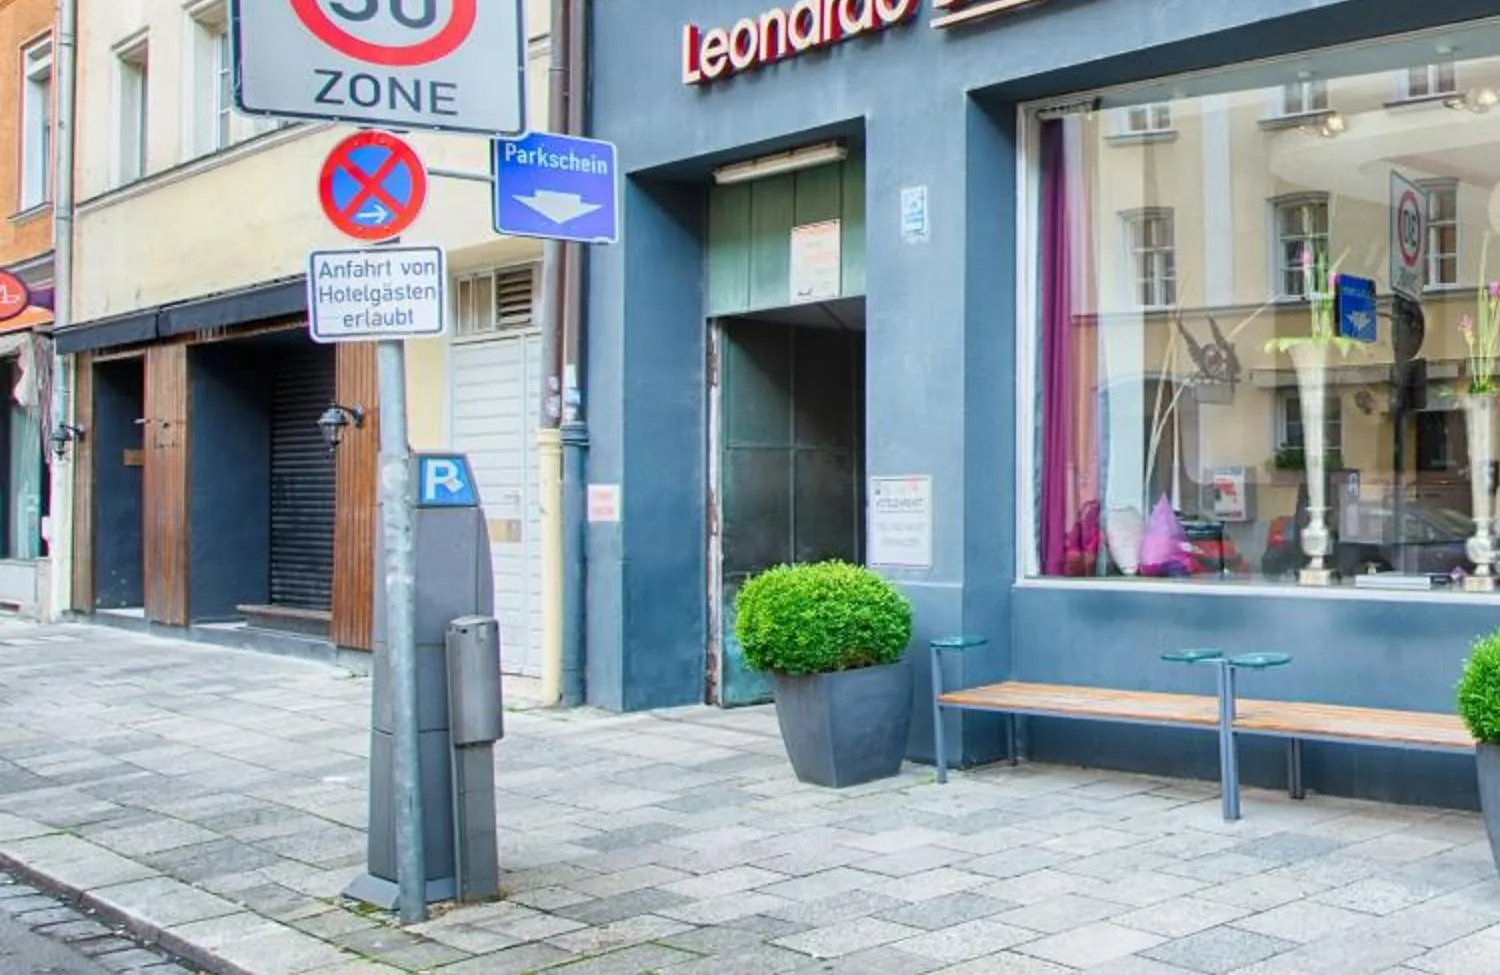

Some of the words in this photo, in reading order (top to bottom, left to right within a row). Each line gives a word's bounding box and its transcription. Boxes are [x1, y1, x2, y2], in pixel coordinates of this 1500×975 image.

[314, 69, 458, 115] ZONE
[505, 142, 607, 174] Parkschein
[320, 259, 391, 278] Anfahrt
[401, 261, 434, 275] von
[319, 283, 436, 306] Hotelgästen
[343, 309, 413, 327] erlaubt
